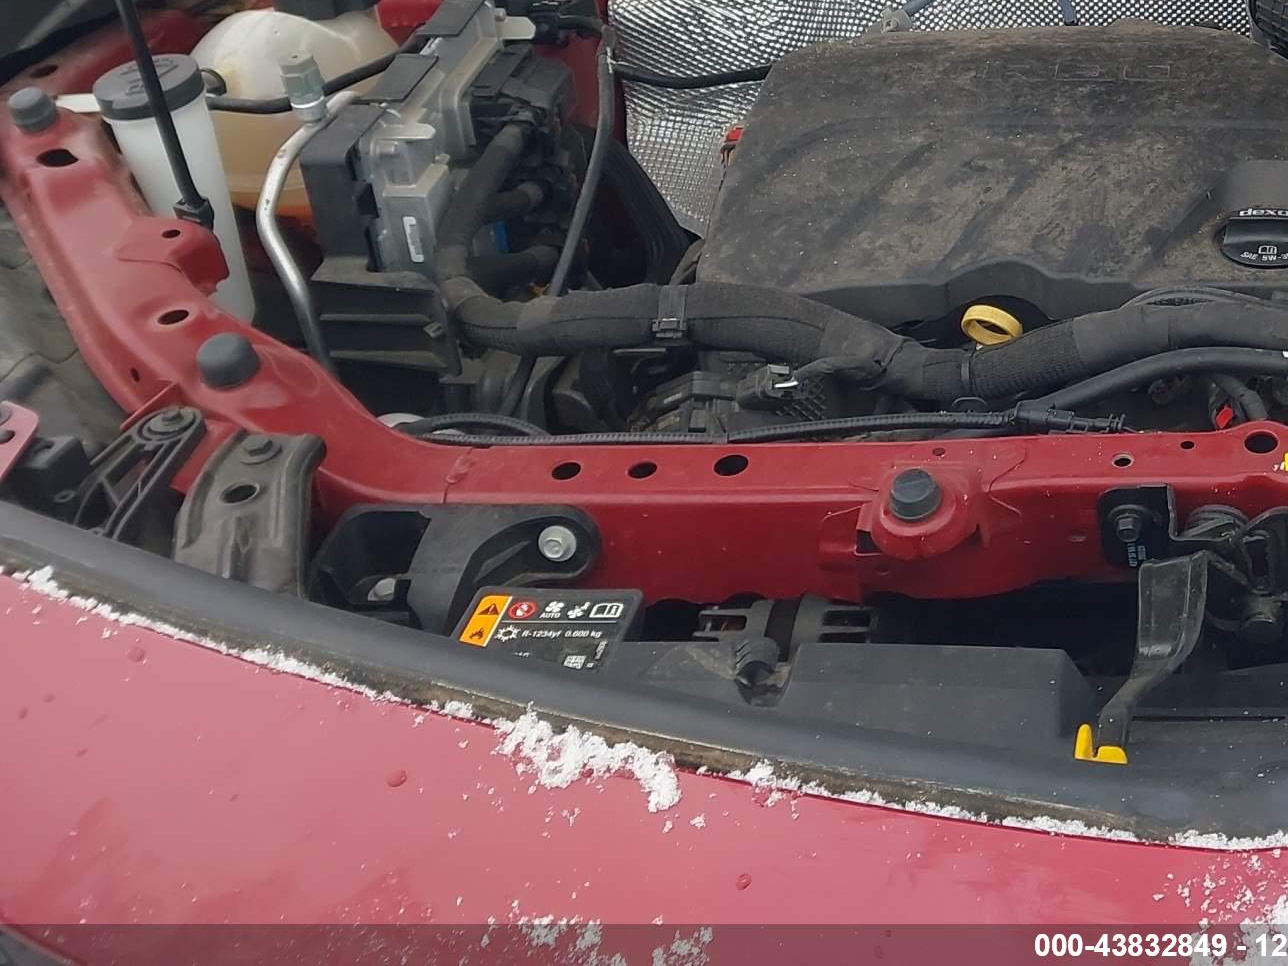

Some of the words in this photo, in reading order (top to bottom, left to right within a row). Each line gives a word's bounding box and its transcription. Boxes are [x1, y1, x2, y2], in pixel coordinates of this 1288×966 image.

[1240, 251, 1259, 260] SAE
[540, 611, 561, 619] AUTO
[590, 630, 603, 640] kg
